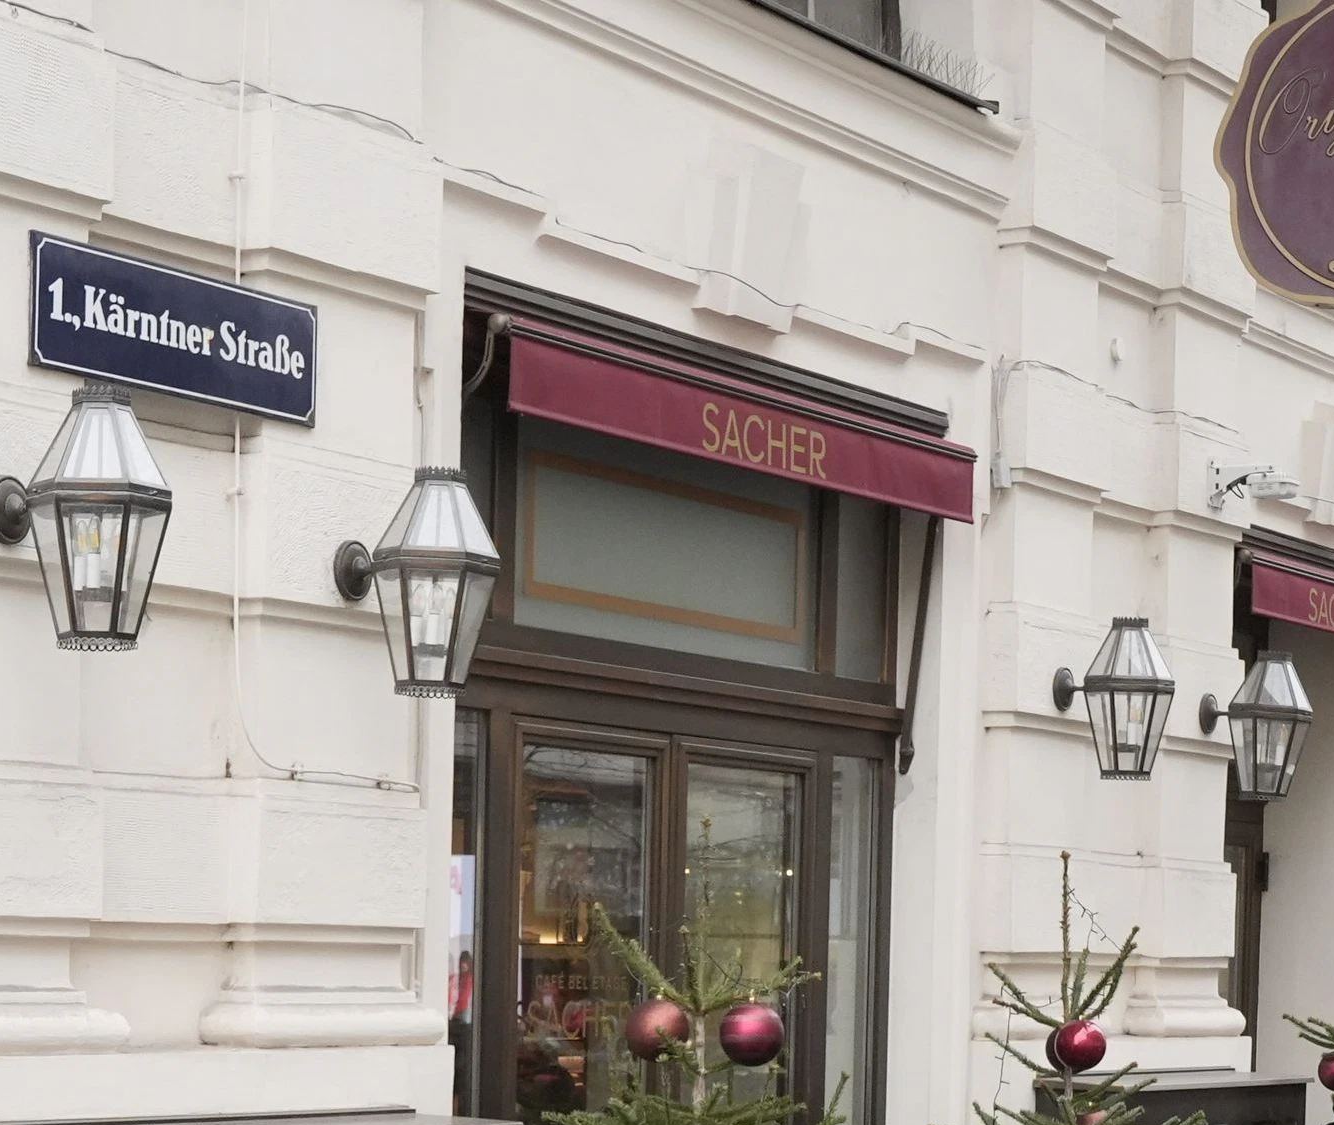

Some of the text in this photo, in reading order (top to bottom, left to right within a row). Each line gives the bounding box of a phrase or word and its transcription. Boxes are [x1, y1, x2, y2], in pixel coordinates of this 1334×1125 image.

[82, 284, 215, 357] Kärntner
[220, 320, 305, 380] Straße
[701, 402, 827, 479] SACHER
